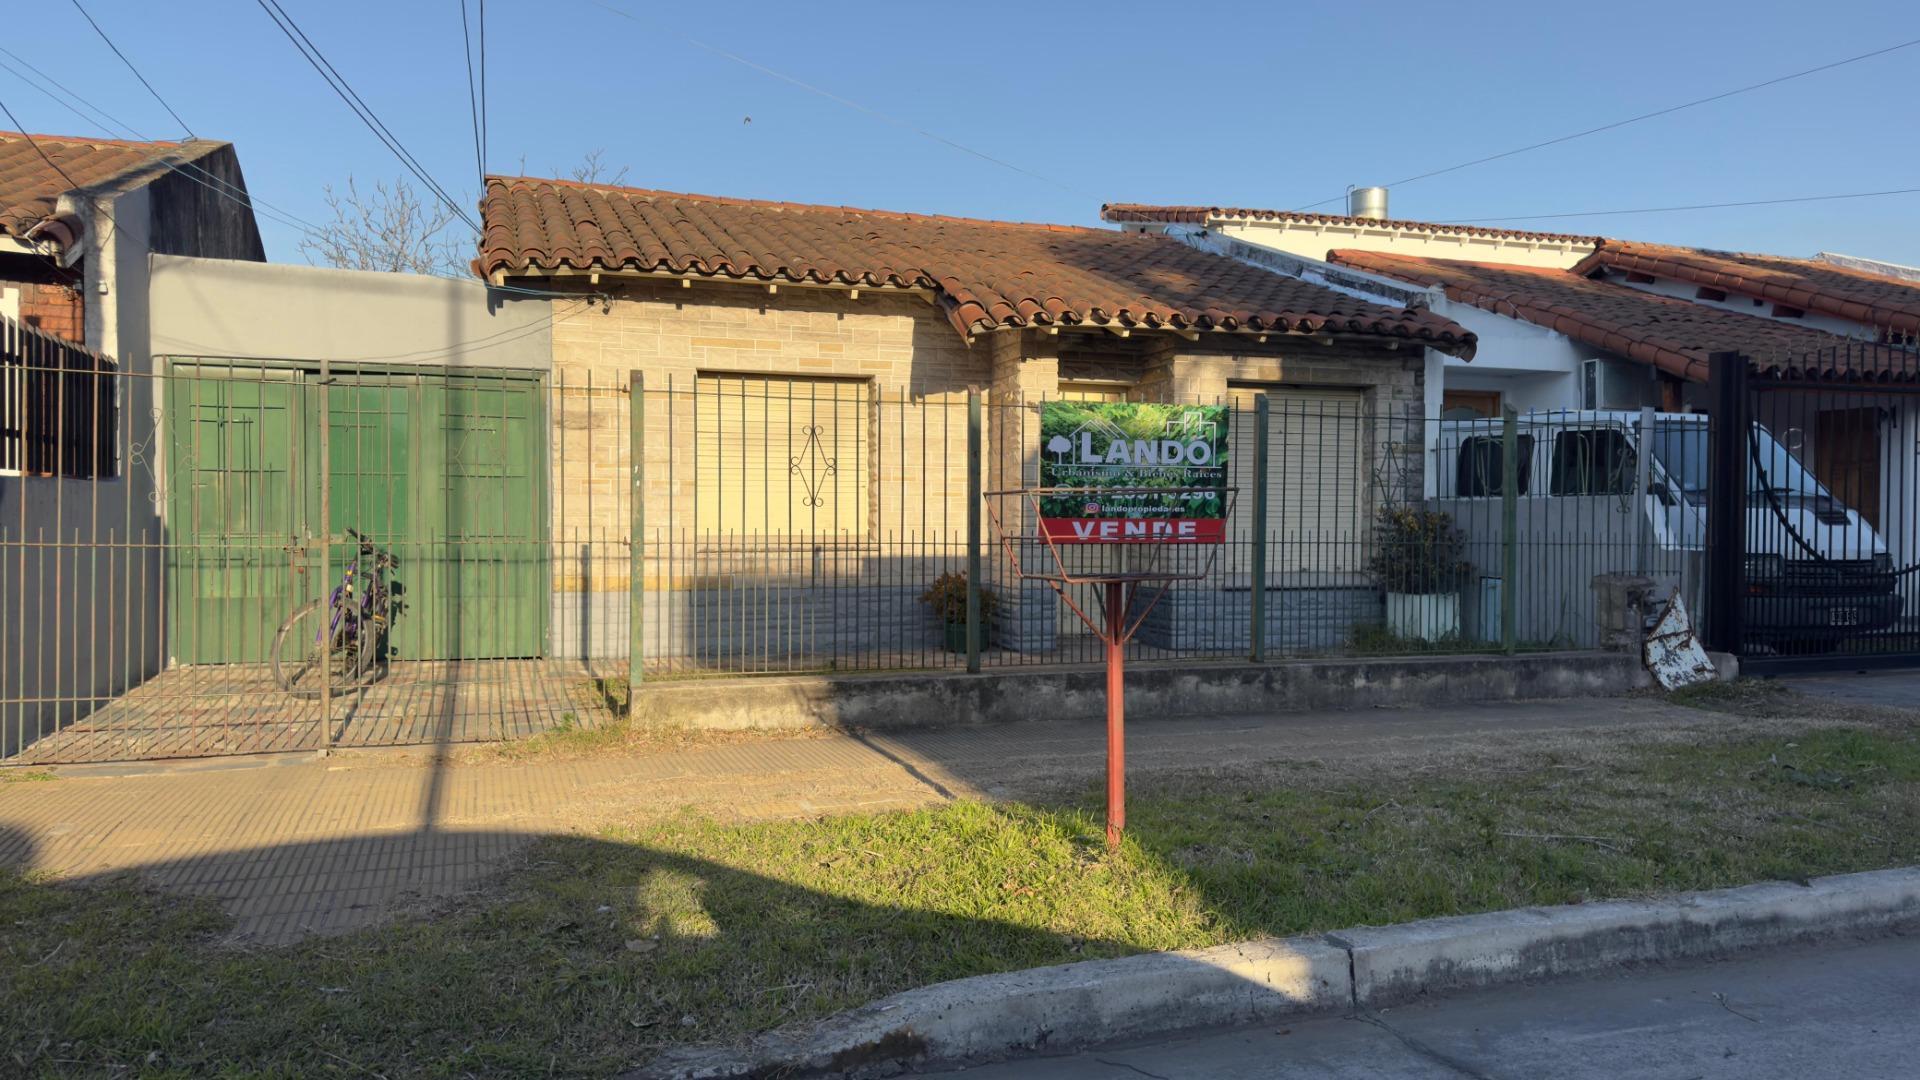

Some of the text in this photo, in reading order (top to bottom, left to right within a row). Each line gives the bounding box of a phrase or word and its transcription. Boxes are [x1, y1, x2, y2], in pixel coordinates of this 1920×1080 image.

[1081, 432, 1212, 465] LANDO
[1052, 467, 1120, 479] Urbanismo
[1124, 469, 1136, 479] &
[1139, 468, 1178, 479] Bienes
[1101, 504, 1185, 514] landopropiedaes
[1072, 521, 1197, 540] VENDE
